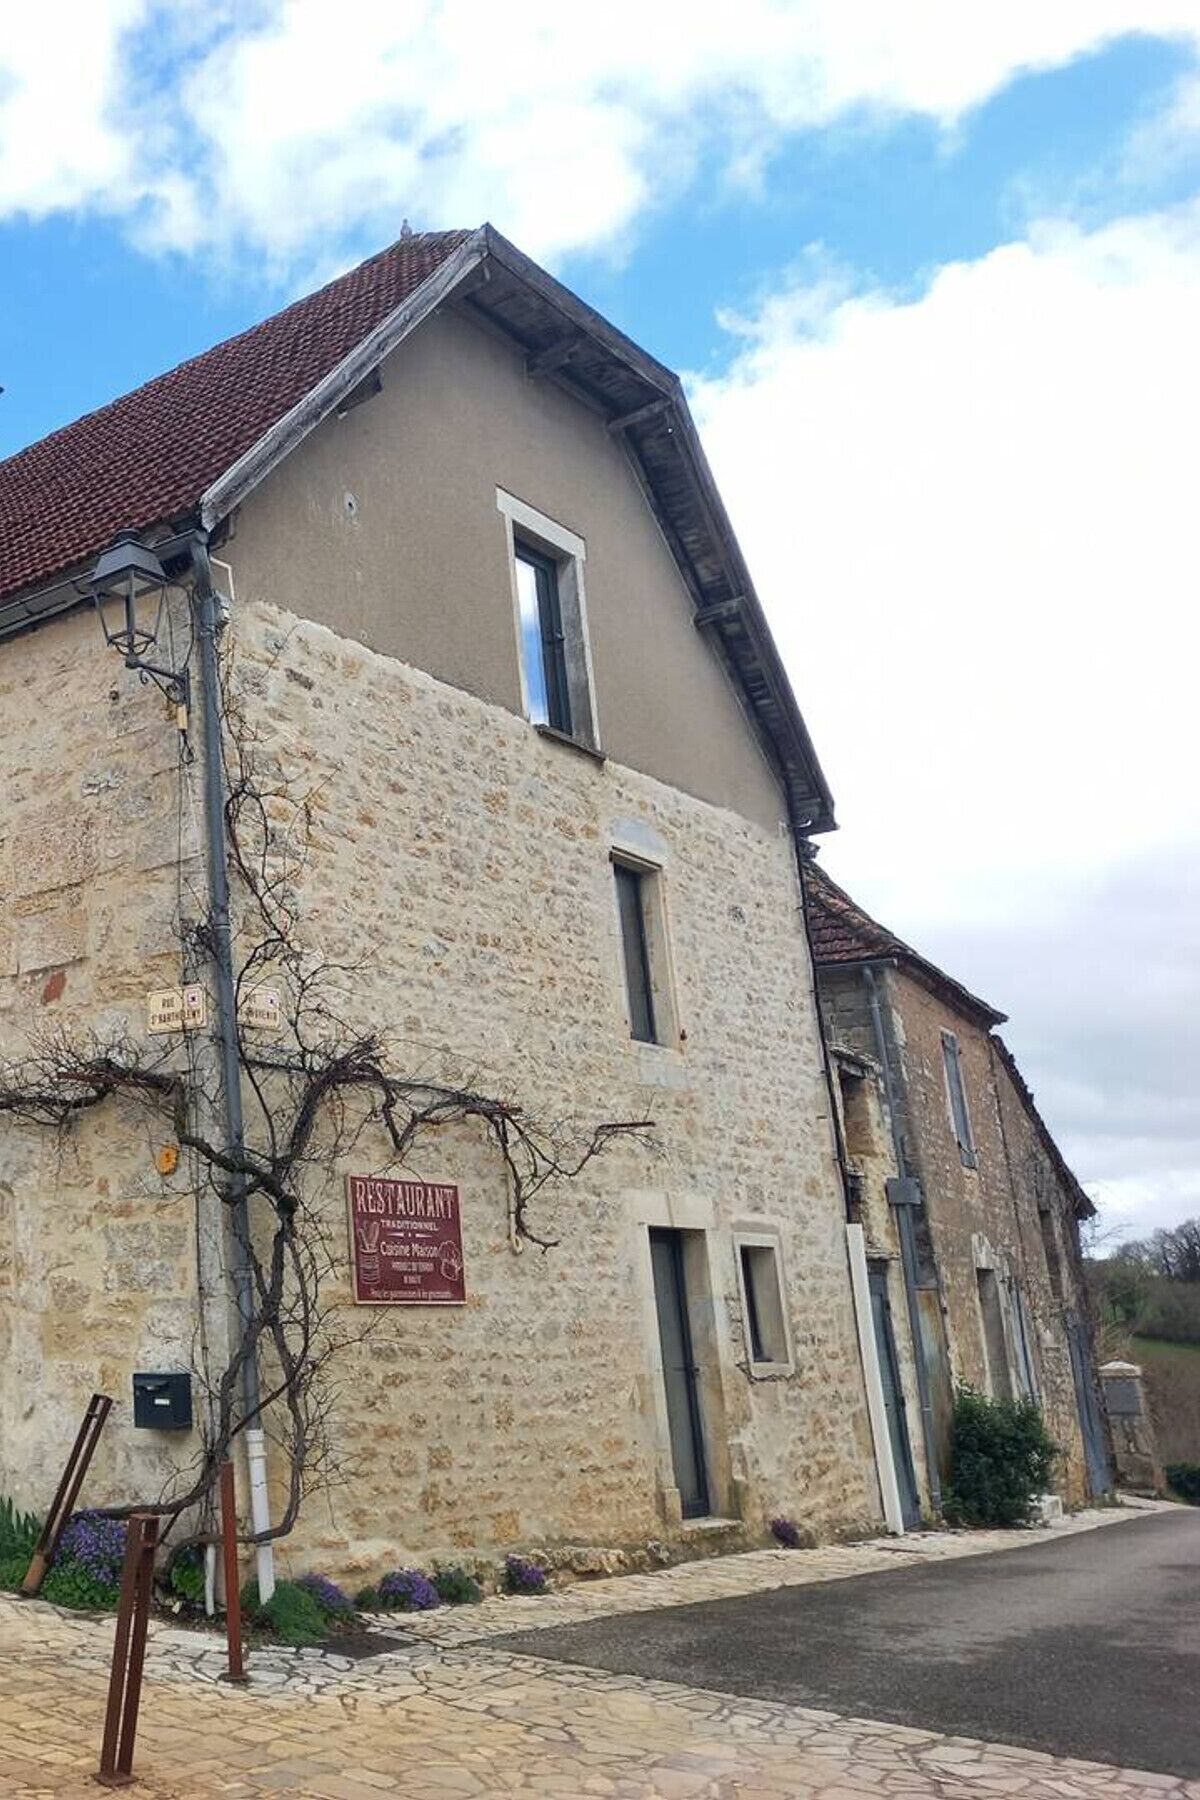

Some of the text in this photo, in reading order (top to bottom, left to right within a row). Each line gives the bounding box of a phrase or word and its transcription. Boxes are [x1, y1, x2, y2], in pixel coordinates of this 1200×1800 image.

[161, 997, 175, 1008] RUE
[356, 1181, 454, 1219] RESTAURANT
[380, 1218, 439, 1231] TRADITIONNEL
[380, 1241, 440, 1258] Cuisine Maison
